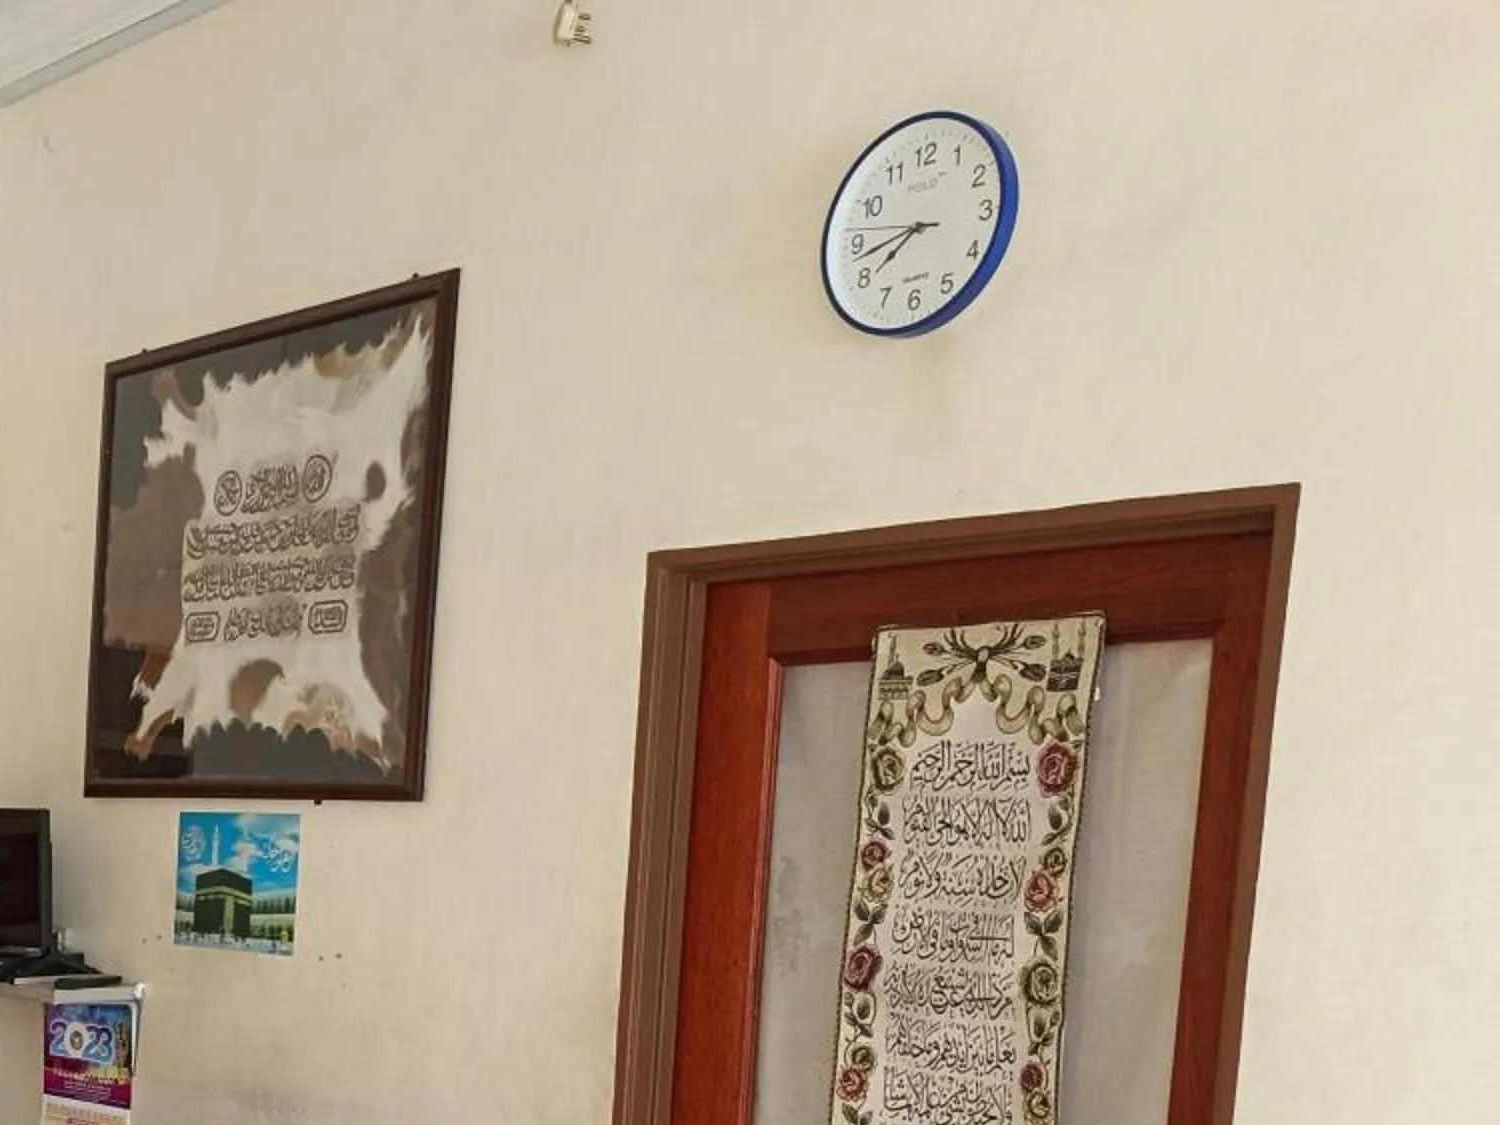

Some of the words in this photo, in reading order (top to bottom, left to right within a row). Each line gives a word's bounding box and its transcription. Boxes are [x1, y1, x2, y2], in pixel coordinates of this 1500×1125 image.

[915, 141, 937, 167] 12
[953, 144, 961, 165] 1
[885, 162, 904, 185] 11
[971, 164, 986, 188] 2
[862, 195, 883, 218] 10
[979, 199, 993, 221] 3
[851, 234, 864, 254] 9
[966, 239, 979, 260] 4
[857, 267, 871, 289] 8
[940, 272, 954, 294] 5
[880, 286, 893, 308] 7
[908, 289, 921, 311] 6
[49, 1018, 115, 1064] 2023
